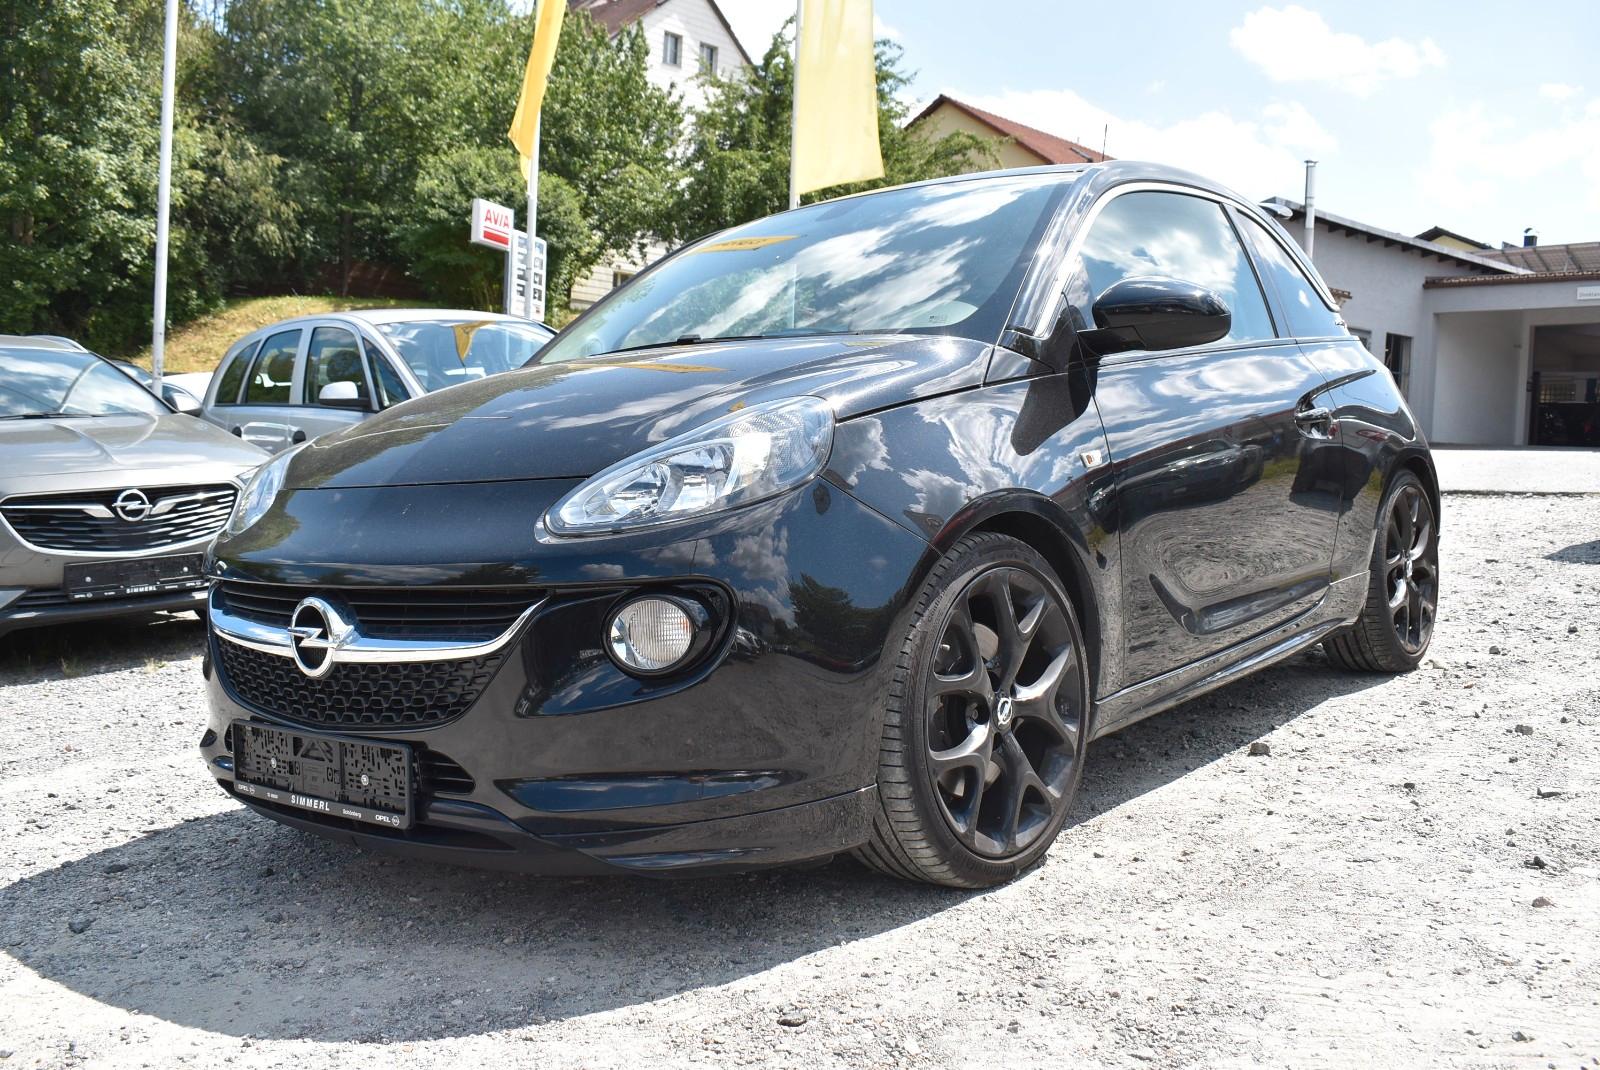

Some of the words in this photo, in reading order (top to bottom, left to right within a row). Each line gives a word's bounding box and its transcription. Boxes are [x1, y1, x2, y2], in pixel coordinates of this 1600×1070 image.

[484, 208, 510, 229] AVIA
[290, 794, 330, 811] SIMMERL
[375, 814, 391, 823] OPEL
